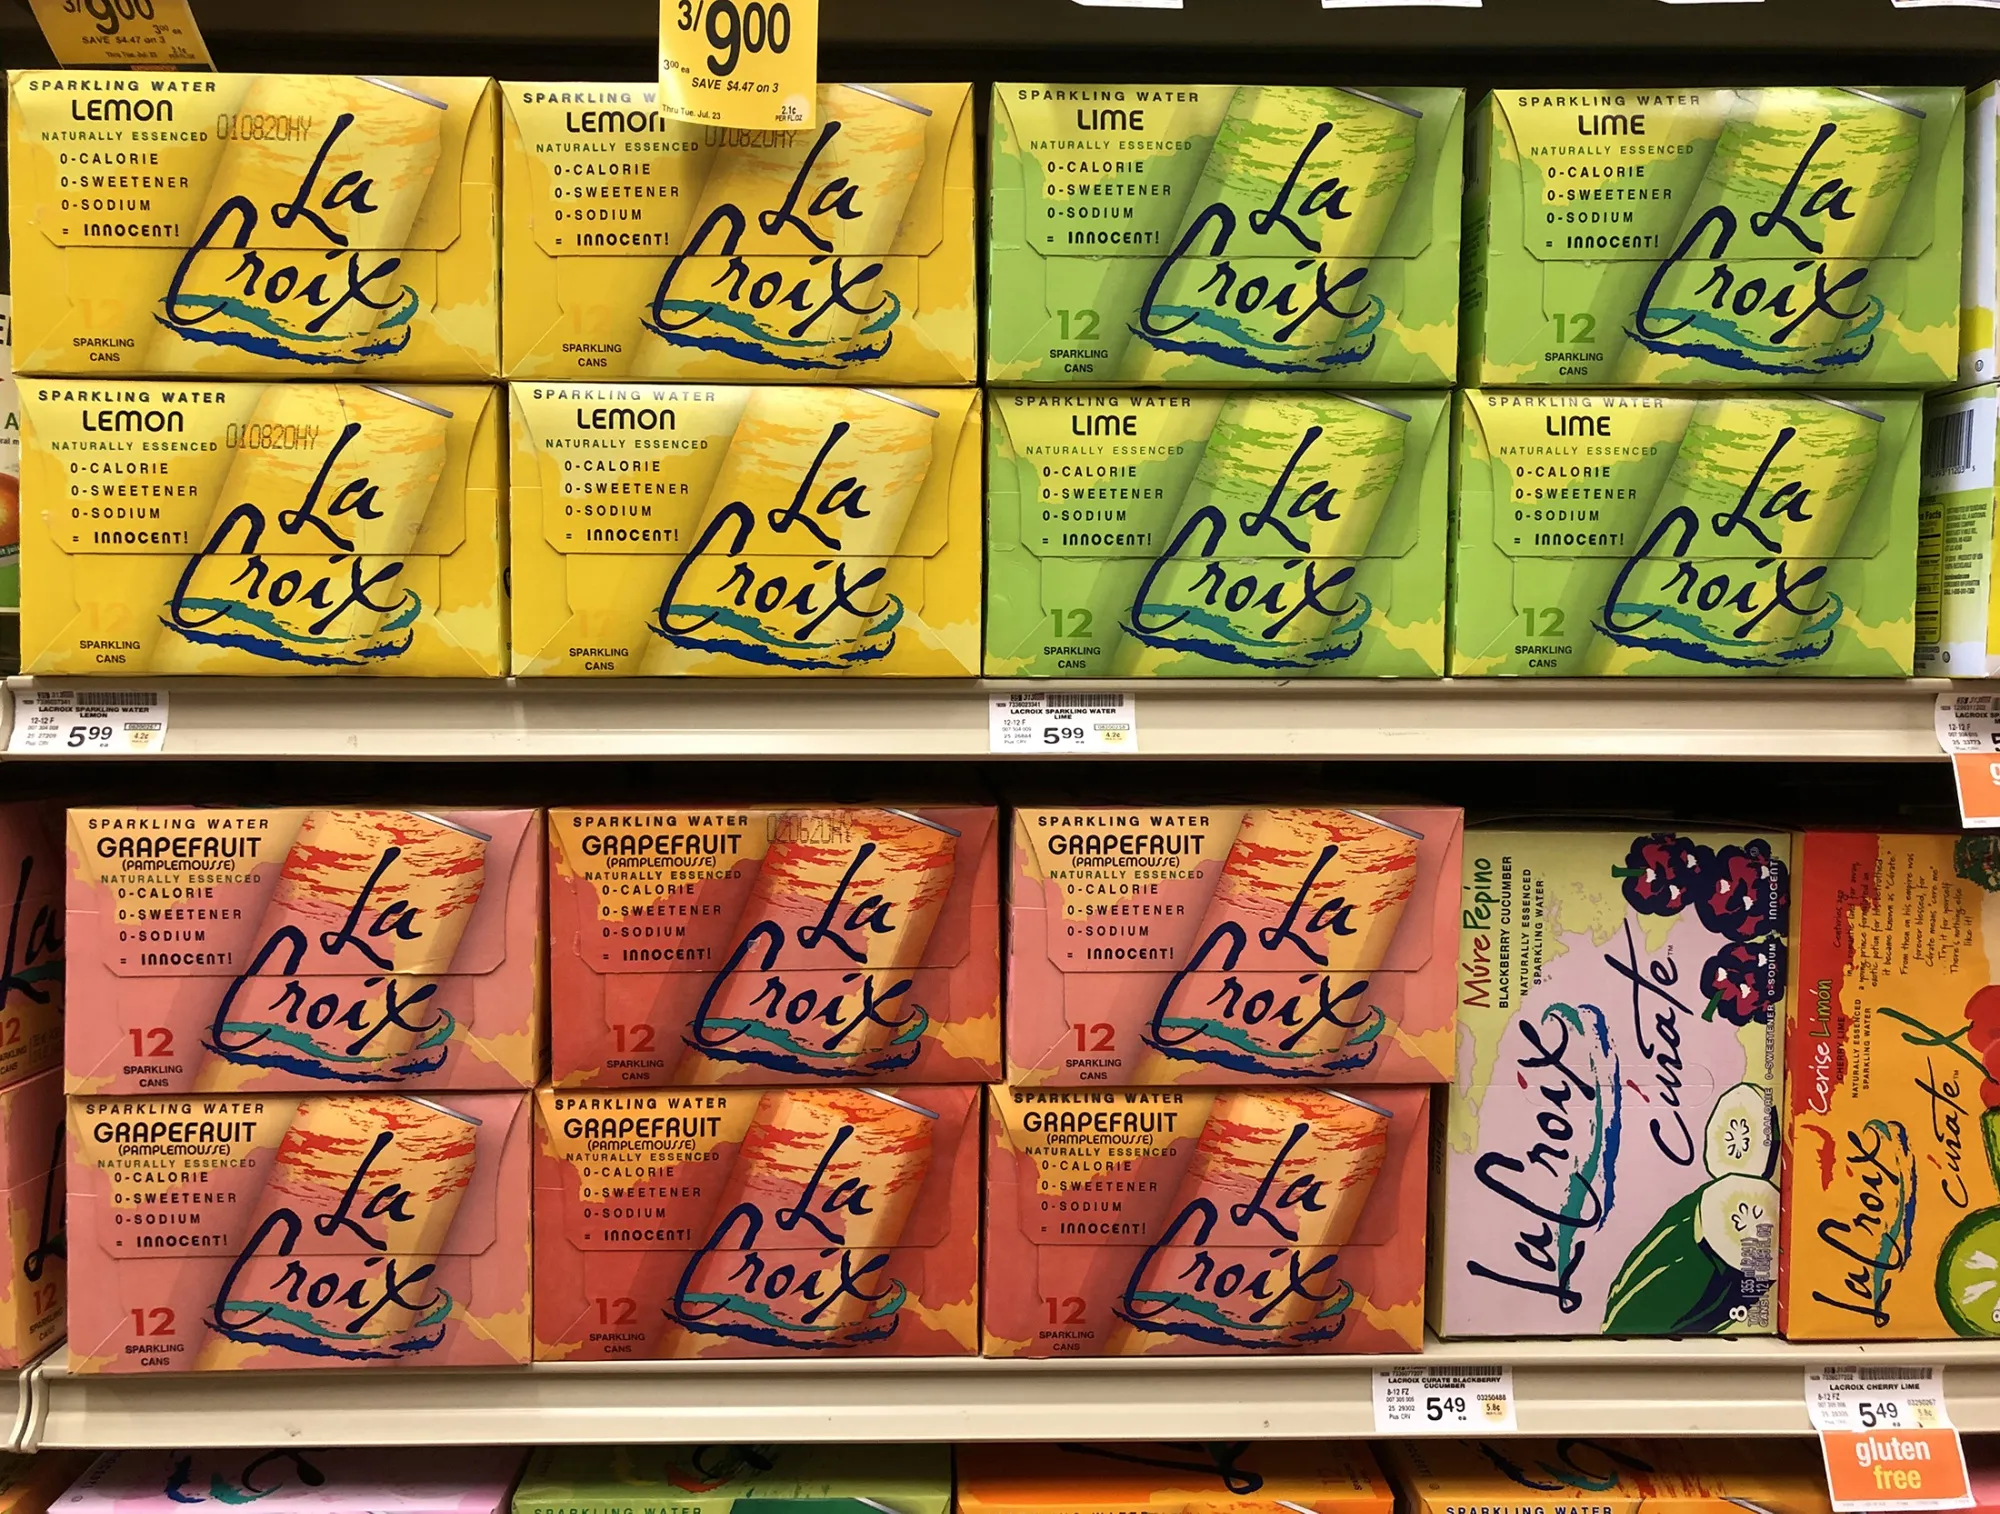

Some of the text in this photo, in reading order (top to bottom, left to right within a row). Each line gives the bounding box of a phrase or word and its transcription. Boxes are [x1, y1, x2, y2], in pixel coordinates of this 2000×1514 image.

[28, 80, 216, 92] SPARKLING WATER
[692, 78, 779, 93] SAVE $4.47 on 3
[1018, 90, 1198, 102] SPARKLING WATER
[72, 99, 173, 121] LEMON
[567, 111, 665, 133] LEMON
[663, 104, 678, 114] Thru
[681, 108, 696, 116] Tue.
[698, 110, 710, 118] Jul.
[1078, 109, 1144, 130] LIME
[42, 131, 208, 141] NATURALLY ESSENCED
[1578, 115, 1646, 135] LIME
[1531, 145, 1693, 156] NATURALLY ESSENCED
[271, 113, 378, 247] La
[1249, 122, 1351, 252] La
[1750, 123, 1854, 254] La
[167, 196, 405, 332] Croix
[1141, 203, 1371, 342] Croix
[1638, 205, 1872, 344] Croix
[1553, 314, 1596, 343] 12
[1049, 349, 1108, 358] SPARKLING
[1064, 364, 1093, 373] CANS
[41, 392, 225, 403] SPARKLING WATER
[83, 410, 183, 432] LEMON
[578, 409, 676, 430] LEMON
[1072, 415, 1137, 435] LIME
[1546, 416, 1611, 436] LIME
[278, 422, 383, 552] La
[768, 421, 871, 554] La
[1240, 426, 1340, 553] La
[174, 503, 408, 635] Croix
[662, 503, 893, 640] Croix
[1133, 505, 1359, 639] Croix
[1523, 608, 1564, 636] 12
[88, 819, 269, 829] SPARKLING WATER
[97, 837, 261, 858] GRAPEFRUIT
[582, 834, 741, 856] GRAPEFRUIT
[1048, 835, 1204, 855] GRAPEFRUIT
[1051, 870, 1203, 880] NATURALLY ESSENCED
[1905, 872, 1915, 901] empire
[321, 847, 422, 970] La
[798, 842, 897, 965] La
[1259, 844, 1356, 966] La
[1463, 858, 1500, 930] Pepino
[1499, 856, 1512, 1008] BLACKBERRY CUCUMBER
[1520, 869, 1531, 996] NATURALLY ESSENCED
[1534, 880, 1544, 985] SPARKLING WATER
[1902, 932, 1911, 951] then
[1914, 928, 1925, 960] forever
[1900, 955, 1910, 975] From
[213, 926, 444, 1054] Croix
[694, 921, 918, 1049] Croix
[1154, 922, 1376, 1049] Croix
[1073, 1024, 1115, 1051] 12
[1808, 979, 1833, 1114] Cerise Limón
[1836, 1041, 1845, 1083] CHERRY
[1852, 1051, 1860, 1098] NATURALLY
[94, 1122, 256, 1143] GRAPEFRUIT
[563, 1117, 721, 1138] GRAPEFRUIT
[1024, 1112, 1178, 1132] GRAPEFRUIT
[315, 1131, 414, 1252] La
[1232, 1122, 1327, 1241] La
[211, 1209, 436, 1333] Croix
[1127, 1198, 1344, 1322] Croix
[1045, 1297, 1087, 1324] 12
[1730, 1306, 1748, 1322] 8
[1856, 1437, 1931, 1467] gluten
[1873, 1465, 1921, 1489] free
